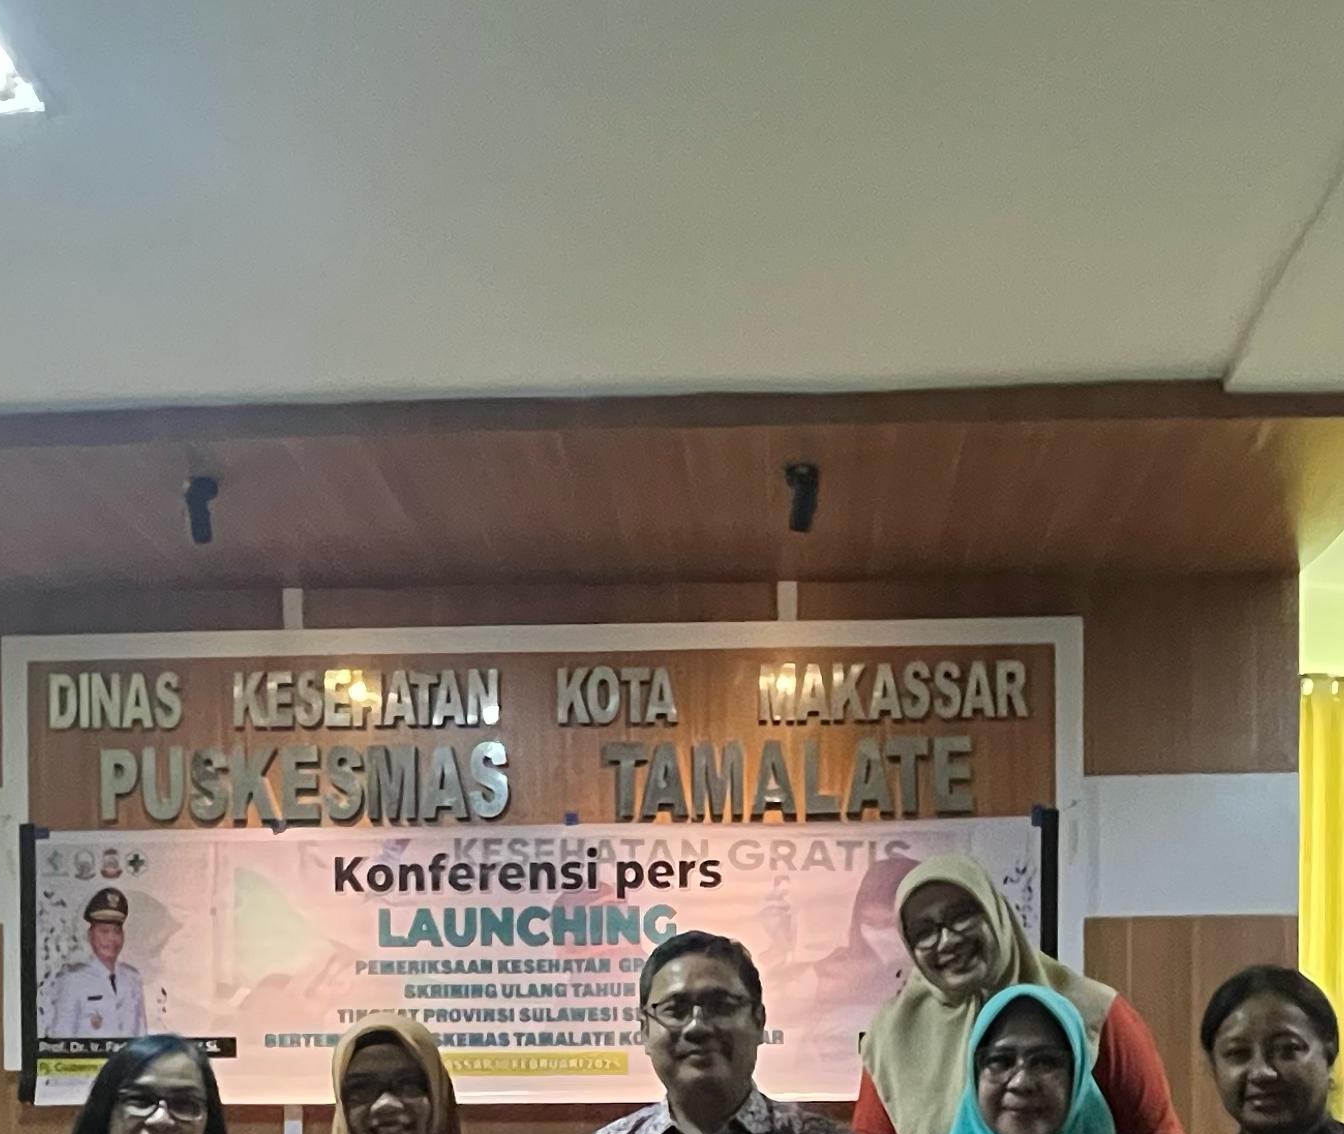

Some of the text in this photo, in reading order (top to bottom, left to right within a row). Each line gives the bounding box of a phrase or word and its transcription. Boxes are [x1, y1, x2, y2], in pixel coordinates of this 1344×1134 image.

[48, 659, 1030, 730] DINAS KESEHATAN KOTA MAKASSAR
[99, 735, 976, 824] PUSKESMAS TAMALATE
[333, 846, 723, 899] Konferensi pers
[377, 904, 678, 948] LAUNCHING
[355, 959, 493, 975] PEMERIKSAAN
[497, 958, 611, 974] KESEHATAN
[501, 983, 567, 998] ULANG
[571, 983, 636, 998] TAHUN
[423, 1008, 515, 1023] PROVINSI
[519, 1007, 618, 1022] SULAWESI
[432, 1032, 510, 1047] SKEMAS
[513, 1031, 616, 1046] TAMALATE
